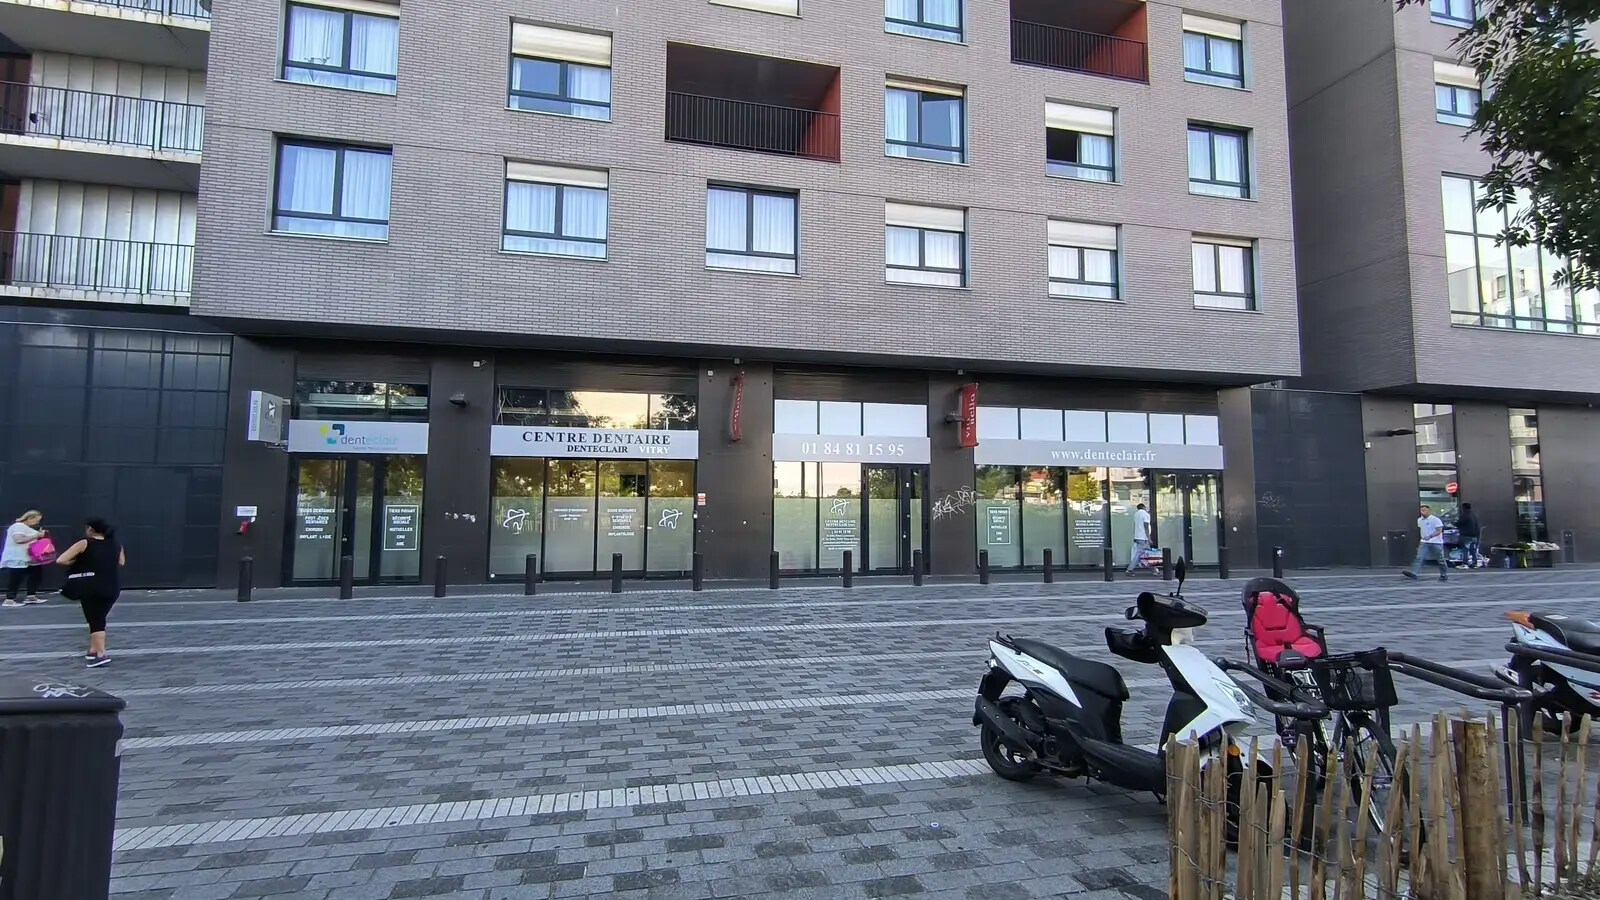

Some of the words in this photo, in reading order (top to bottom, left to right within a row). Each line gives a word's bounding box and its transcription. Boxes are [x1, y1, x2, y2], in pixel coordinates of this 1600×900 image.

[341, 435, 398, 445] denteclair
[522, 431, 587, 443] CENTRE
[592, 433, 671, 445] DENTAIRE
[567, 445, 628, 453] DENTECLAIR
[639, 446, 670, 454] VITRY
[802, 442, 817, 454] 01
[824, 442, 840, 455] 84
[846, 443, 861, 455] 81
[867, 444, 883, 456] 15
[888, 444, 904, 456] 95
[1051, 448, 1157, 461] www.denteclair.fr
